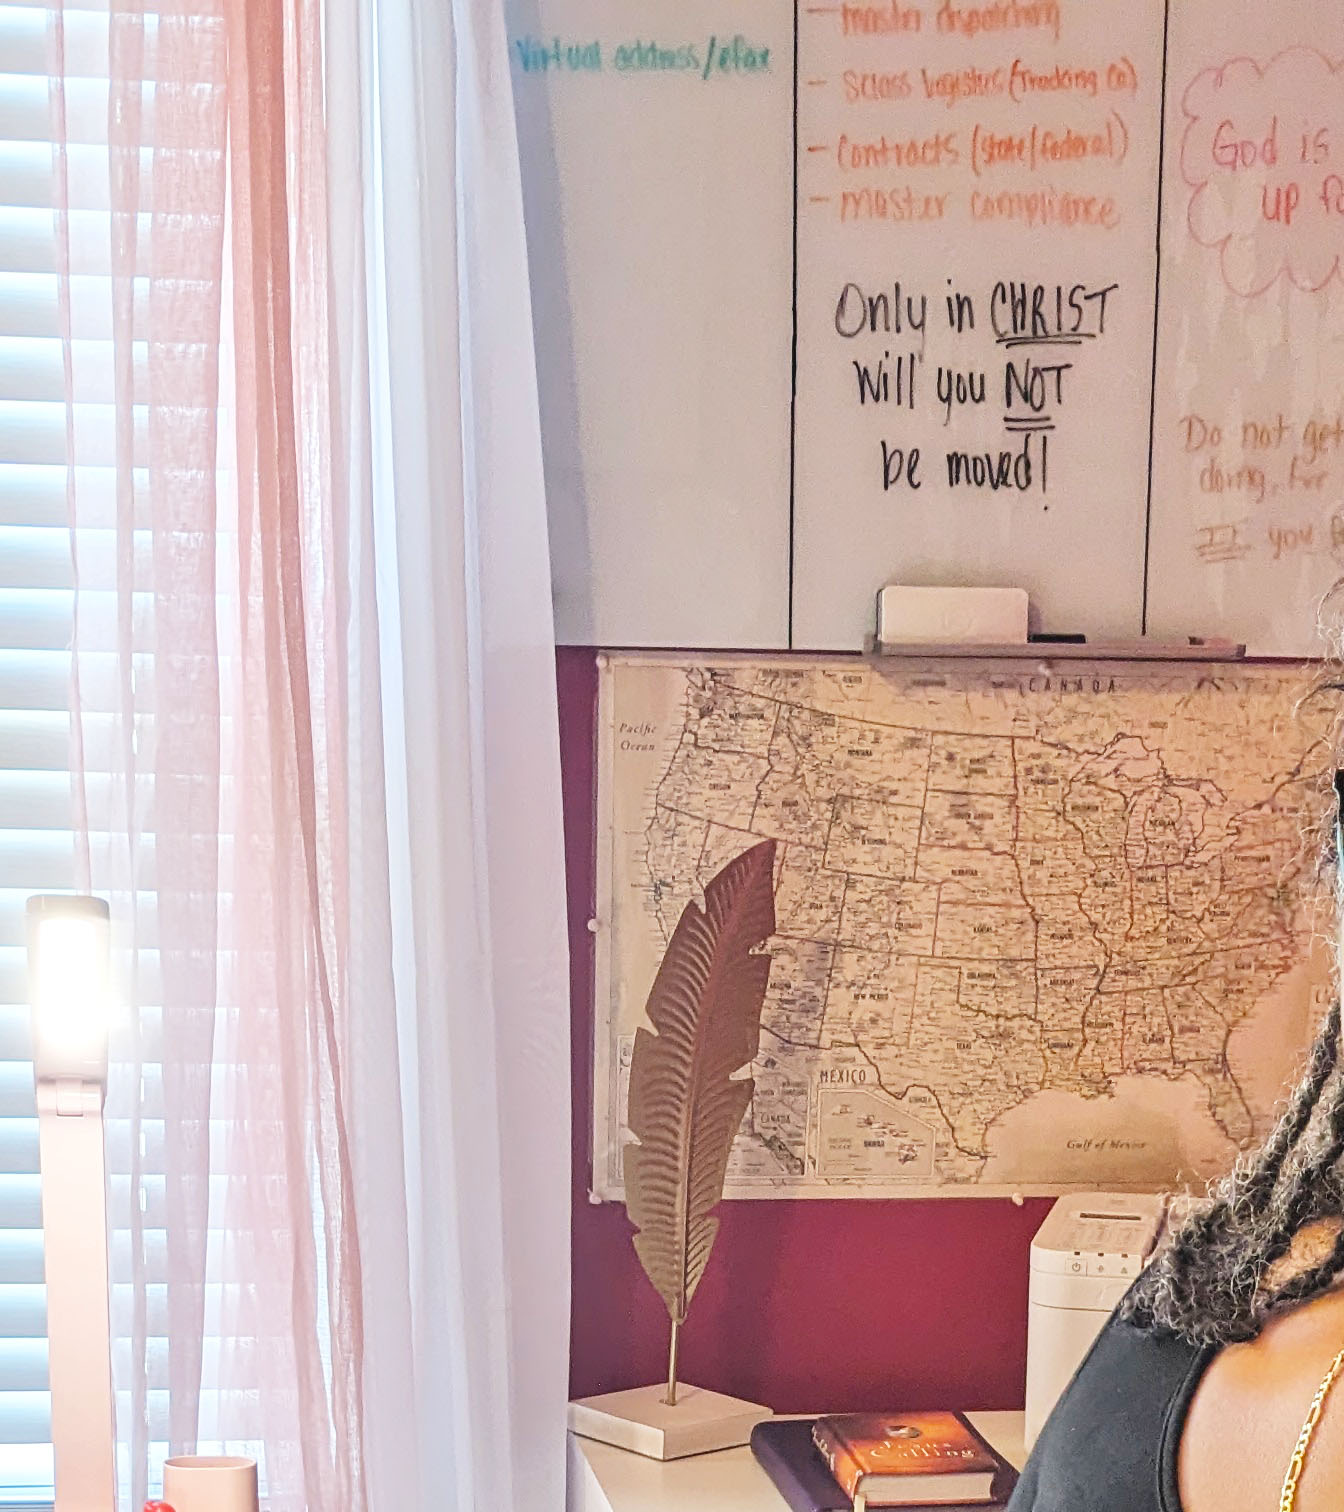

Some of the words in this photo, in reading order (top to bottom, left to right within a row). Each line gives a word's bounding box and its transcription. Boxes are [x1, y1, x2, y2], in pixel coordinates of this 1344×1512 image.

[1211, 115, 1278, 172] God
[1300, 128, 1330, 165] is
[835, 281, 928, 362] Only
[946, 279, 976, 334] in
[991, 281, 1120, 340] CHRIST
[936, 366, 986, 428] you
[1004, 358, 1074, 413] NOT
[1180, 413, 1223, 454] Do
[1241, 412, 1291, 450] not
[1302, 415, 1344, 465] get
[879, 440, 922, 491] be
[946, 431, 1050, 513] moved!
[1028, 676, 1116, 696] CANADA
